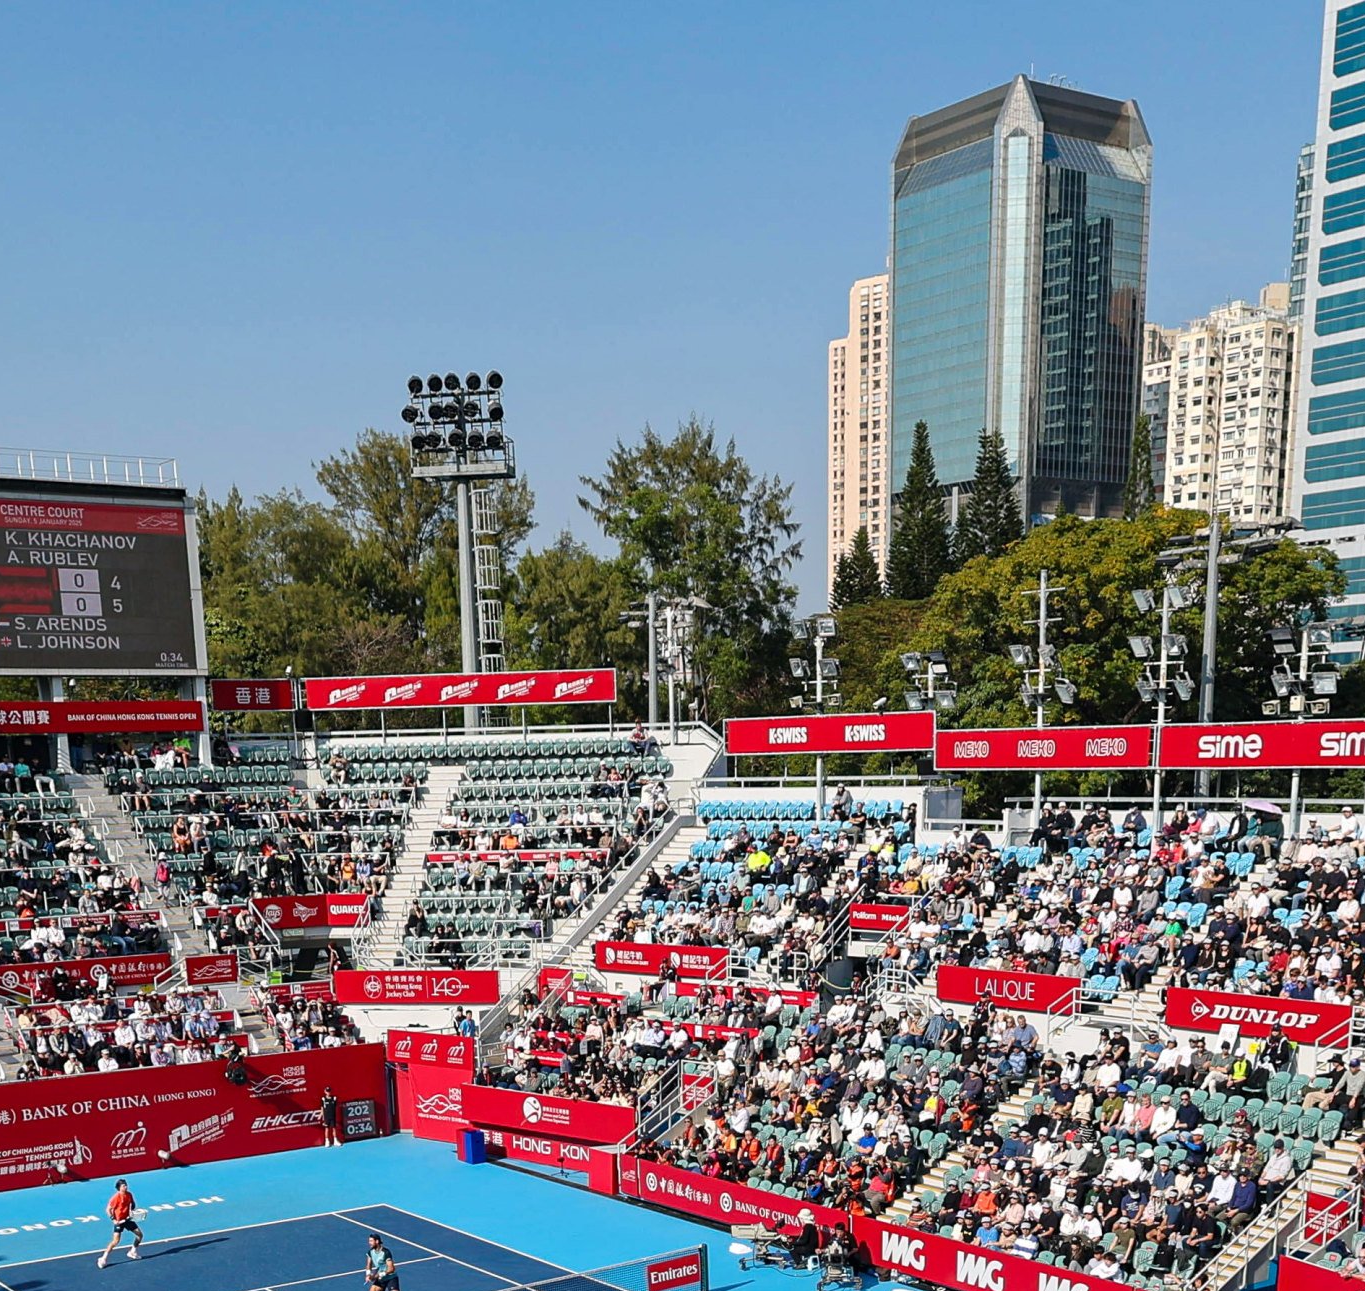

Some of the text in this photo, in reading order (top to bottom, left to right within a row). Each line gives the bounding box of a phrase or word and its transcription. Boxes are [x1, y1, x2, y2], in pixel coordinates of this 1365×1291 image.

[0, 504, 84, 519] CENTRE COURT
[5, 531, 136, 550] K. KHACHANOV
[7, 551, 99, 566] A. RUBLEV
[74, 573, 121, 590] 0 4
[77, 597, 122, 613] 0 5
[15, 617, 106, 631] S. ARENDS
[17, 635, 120, 649] L. JOHNSON
[160, 652, 183, 662] 0:34
[236, 687, 271, 704] 香港
[179, 712, 196, 720] OPEN
[954, 740, 989, 758] MEKO
[1018, 739, 1055, 757] MEKO
[1085, 737, 1127, 757] MEKO
[975, 977, 1036, 1001] LALIQUE
[1210, 1004, 1320, 1028] DUNLOP
[22, 1088, 217, 1122] BANK OF CHINA (HONG KONG)
[347, 1105, 370, 1117] 202
[347, 1122, 373, 1136] 0:34
[2, 1150, 11, 1158] OF
[11, 1148, 33, 1157] CHINA
[33, 1144, 54, 1153] HONG
[54, 1141, 74, 1151] KONG
[512, 1135, 552, 1155] HONG
[25, 1149, 74, 1162] TENNIS OPEN
[735, 1201, 758, 1217] BANK
[759, 1206, 770, 1218] OF
[771, 1209, 801, 1228] CHINA
[881, 1230, 926, 1272] IMG
[650, 1263, 698, 1284] Emirates
